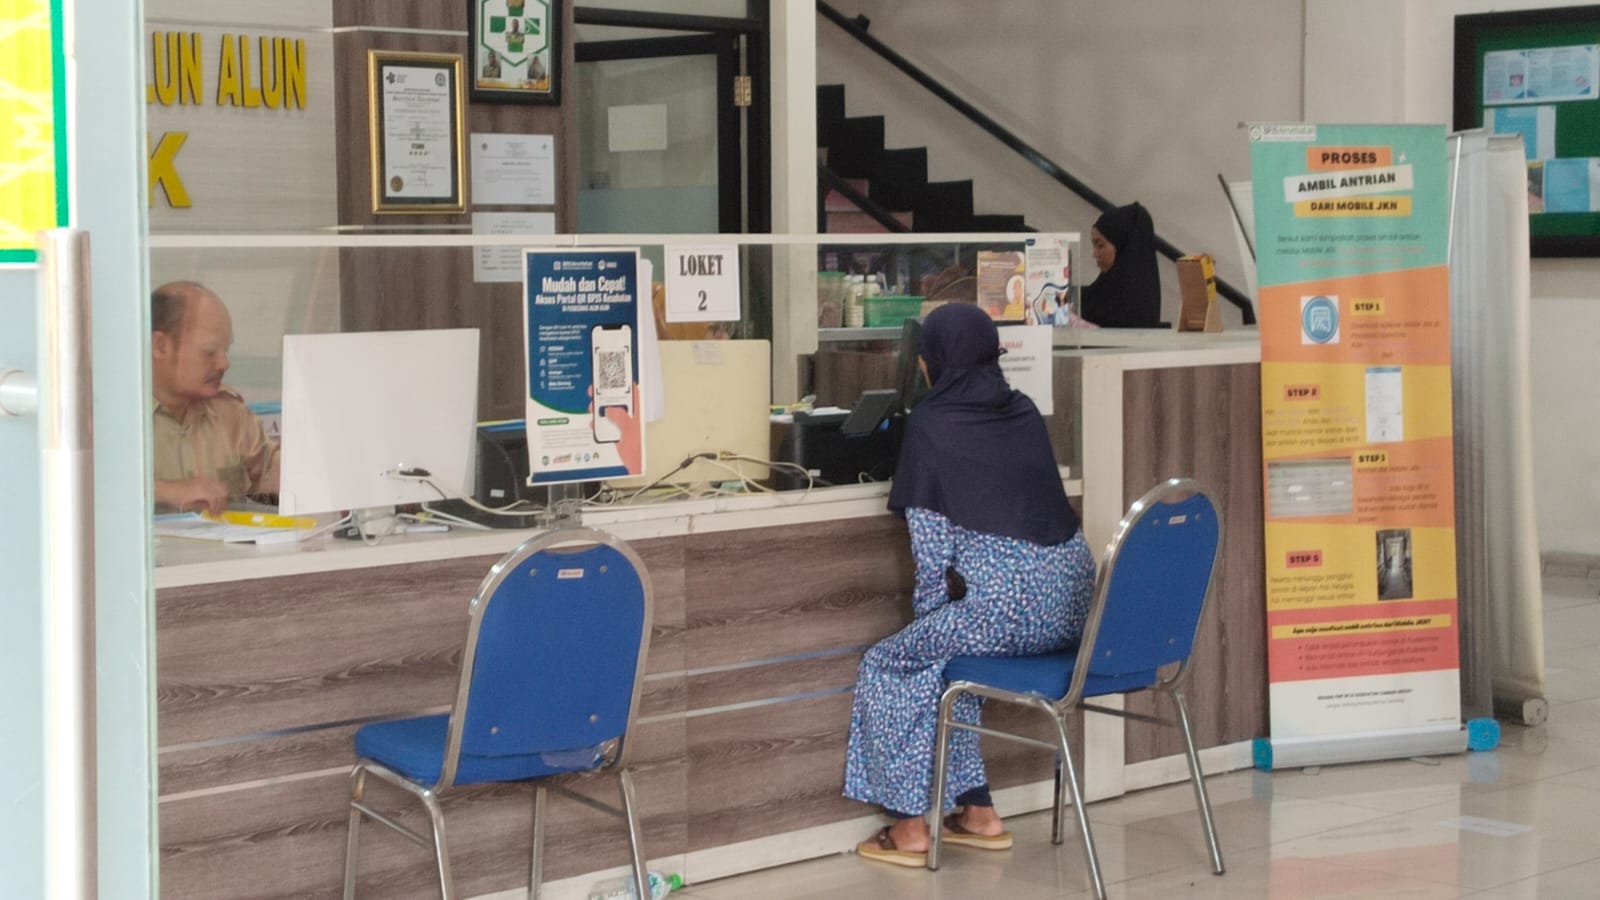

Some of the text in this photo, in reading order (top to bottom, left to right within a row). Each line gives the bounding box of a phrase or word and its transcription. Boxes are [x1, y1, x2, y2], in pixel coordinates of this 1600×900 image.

[216, 34, 306, 109] ALUN
[1321, 152, 1377, 164] PROSES
[1298, 172, 1396, 193] AMBIL ANTRIAN
[1310, 201, 1398, 212] DARI MOBILE JKN
[680, 254, 724, 276] LOKET
[542, 275, 626, 294] Mudah dan Cepat!
[557, 294, 576, 304] Portal
[577, 293, 586, 304] QR
[698, 290, 708, 311] 2
[1354, 303, 1374, 311] STEP
[1287, 388, 1317, 397] STEP 2
[1358, 455, 1379, 463] STEP
[1290, 555, 1311, 564] STEP
